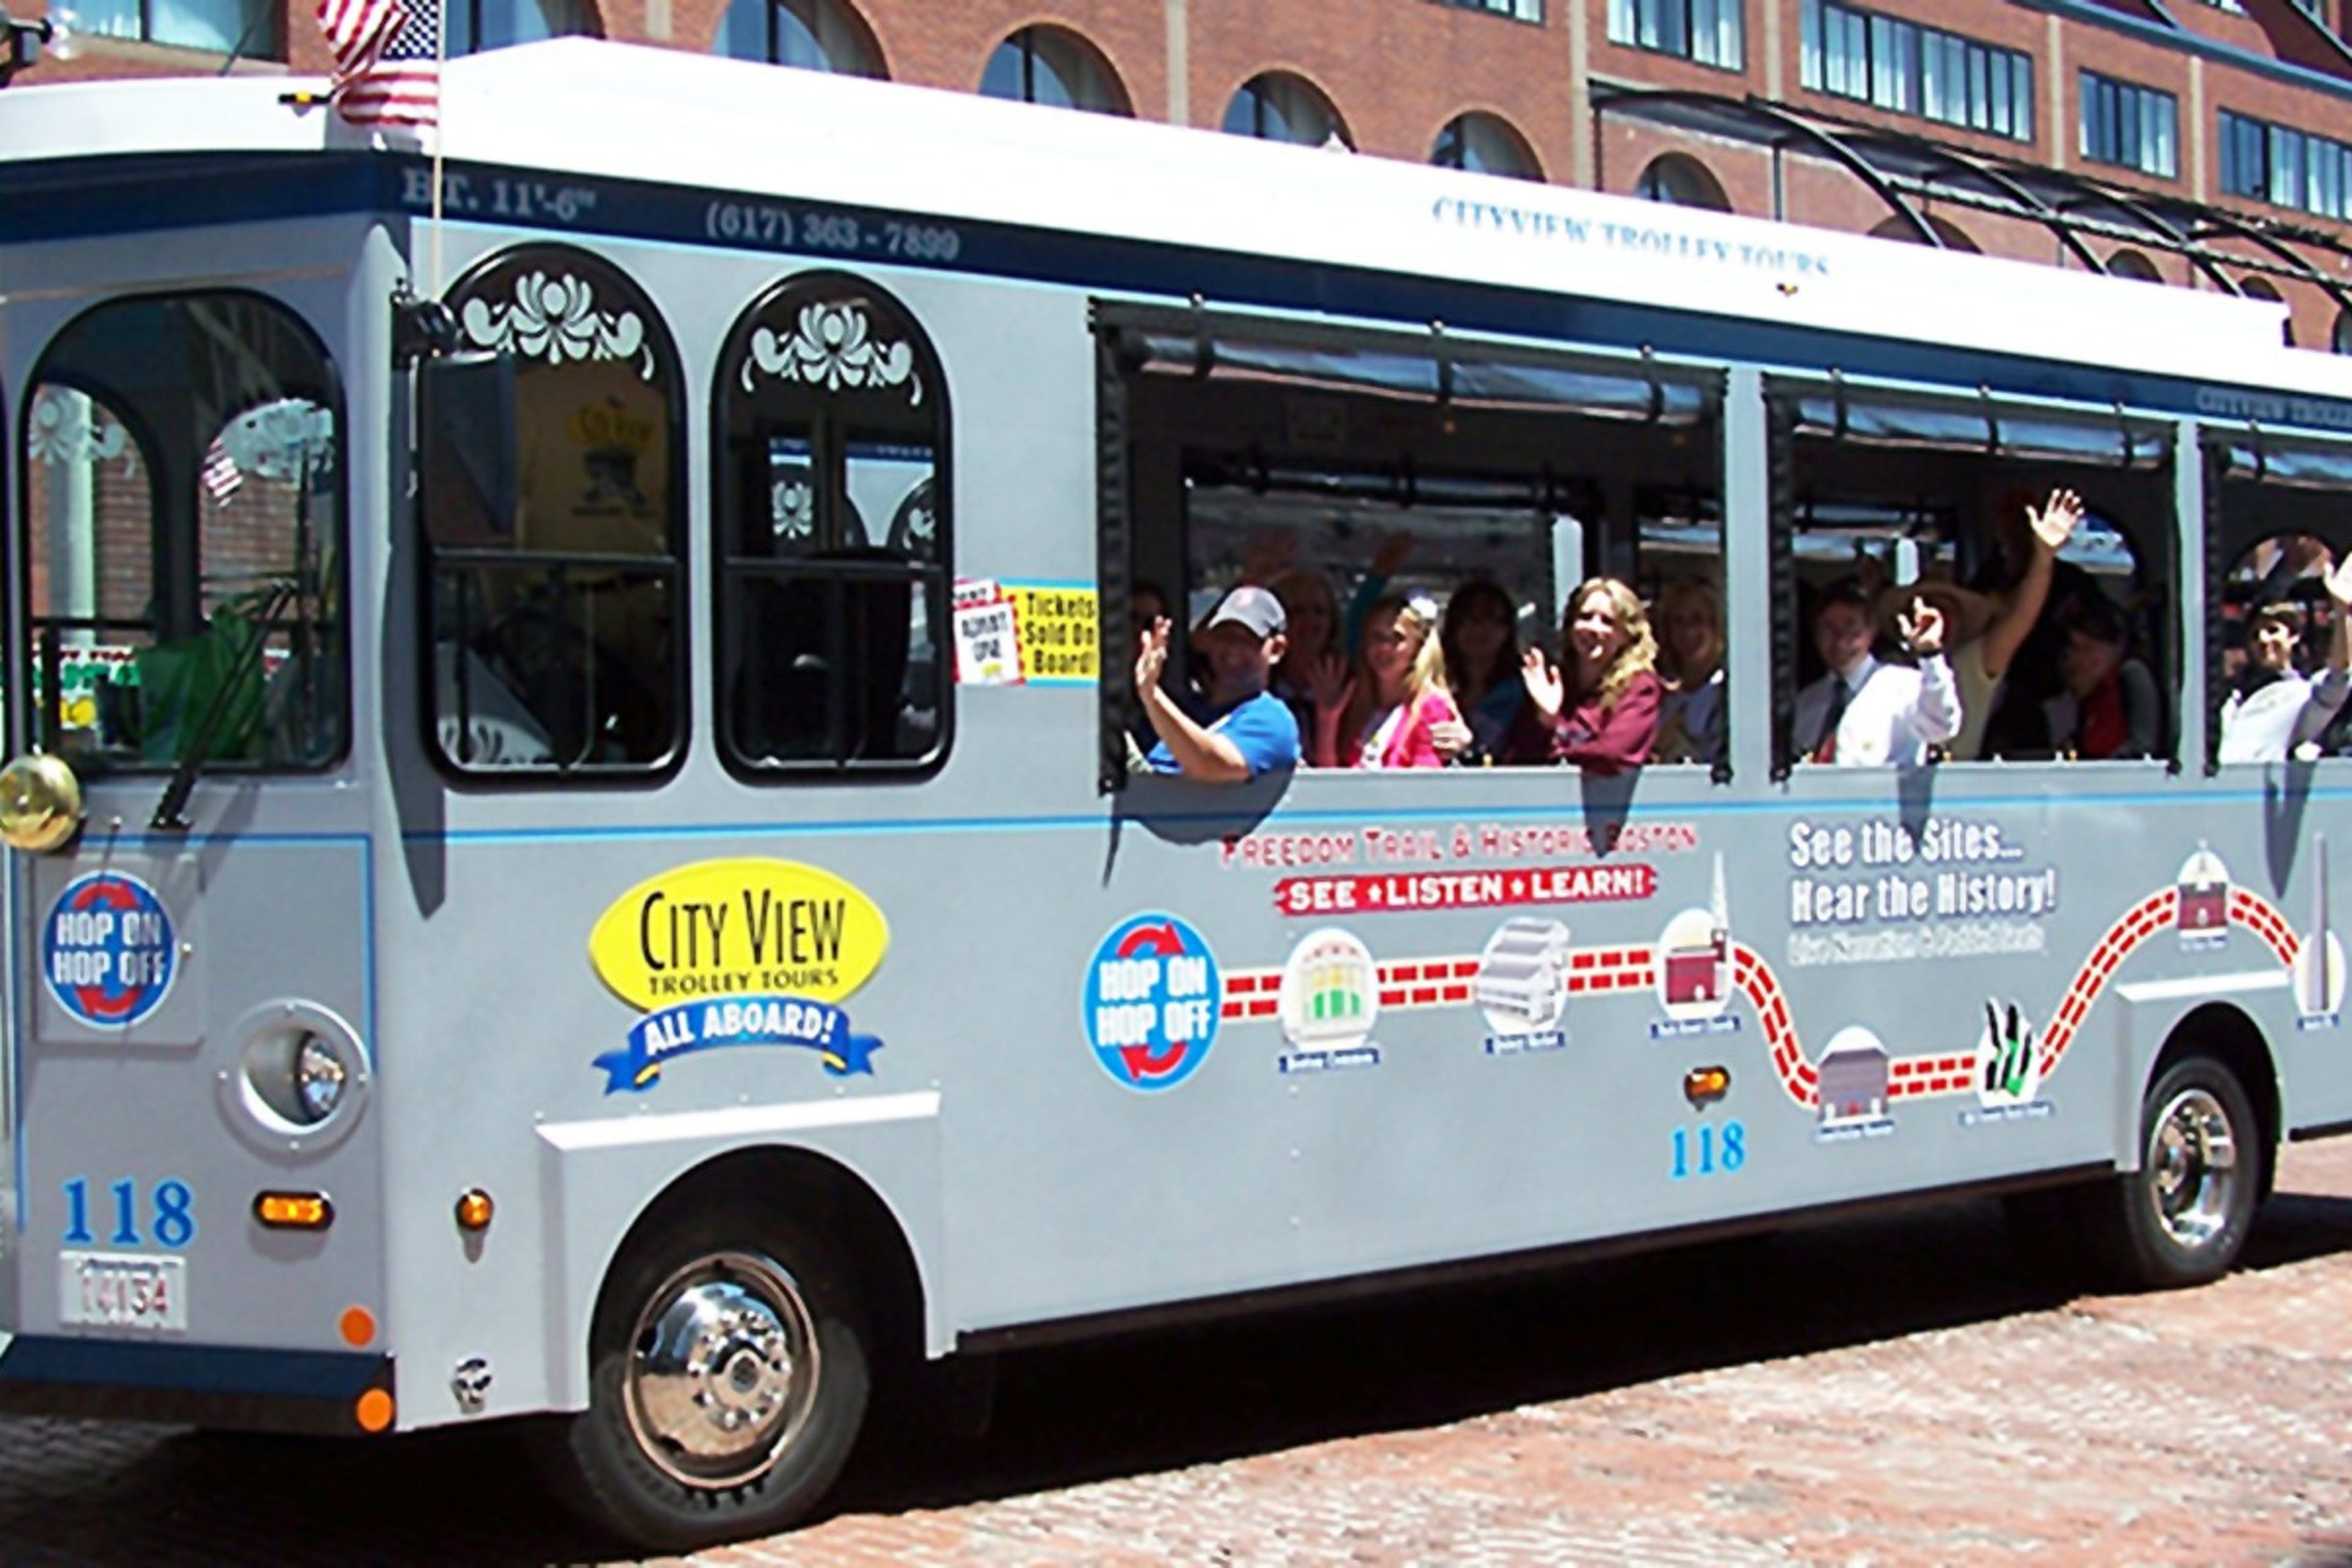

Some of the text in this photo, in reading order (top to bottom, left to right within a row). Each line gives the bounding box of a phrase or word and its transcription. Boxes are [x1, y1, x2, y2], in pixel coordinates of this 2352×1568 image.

[706, 201, 793, 245] (617)
[803, 214, 858, 249] 363
[1025, 620, 1066, 646] Sold
[1221, 831, 1355, 868] FREEDOM
[1362, 826, 1442, 864] TRAIL
[1453, 824, 1469, 859] &
[1790, 821, 1853, 867] See
[1861, 821, 1913, 864] the
[1288, 869, 1645, 911] SEE LISTEN LEARN!
[1792, 867, 2057, 922] Hear the History!
[58, 912, 160, 945] HOP ON
[641, 889, 845, 970] CITY VIEW
[53, 951, 164, 985] HOP OFF
[649, 968, 838, 995] TROLLEY TOURS
[1099, 956, 1207, 1001] HOP ON
[645, 1003, 837, 1056] ALL ABOARD!
[1096, 999, 1211, 1047] HOP OFF
[1670, 1120, 1746, 1177] 118
[63, 1177, 196, 1248] 118
